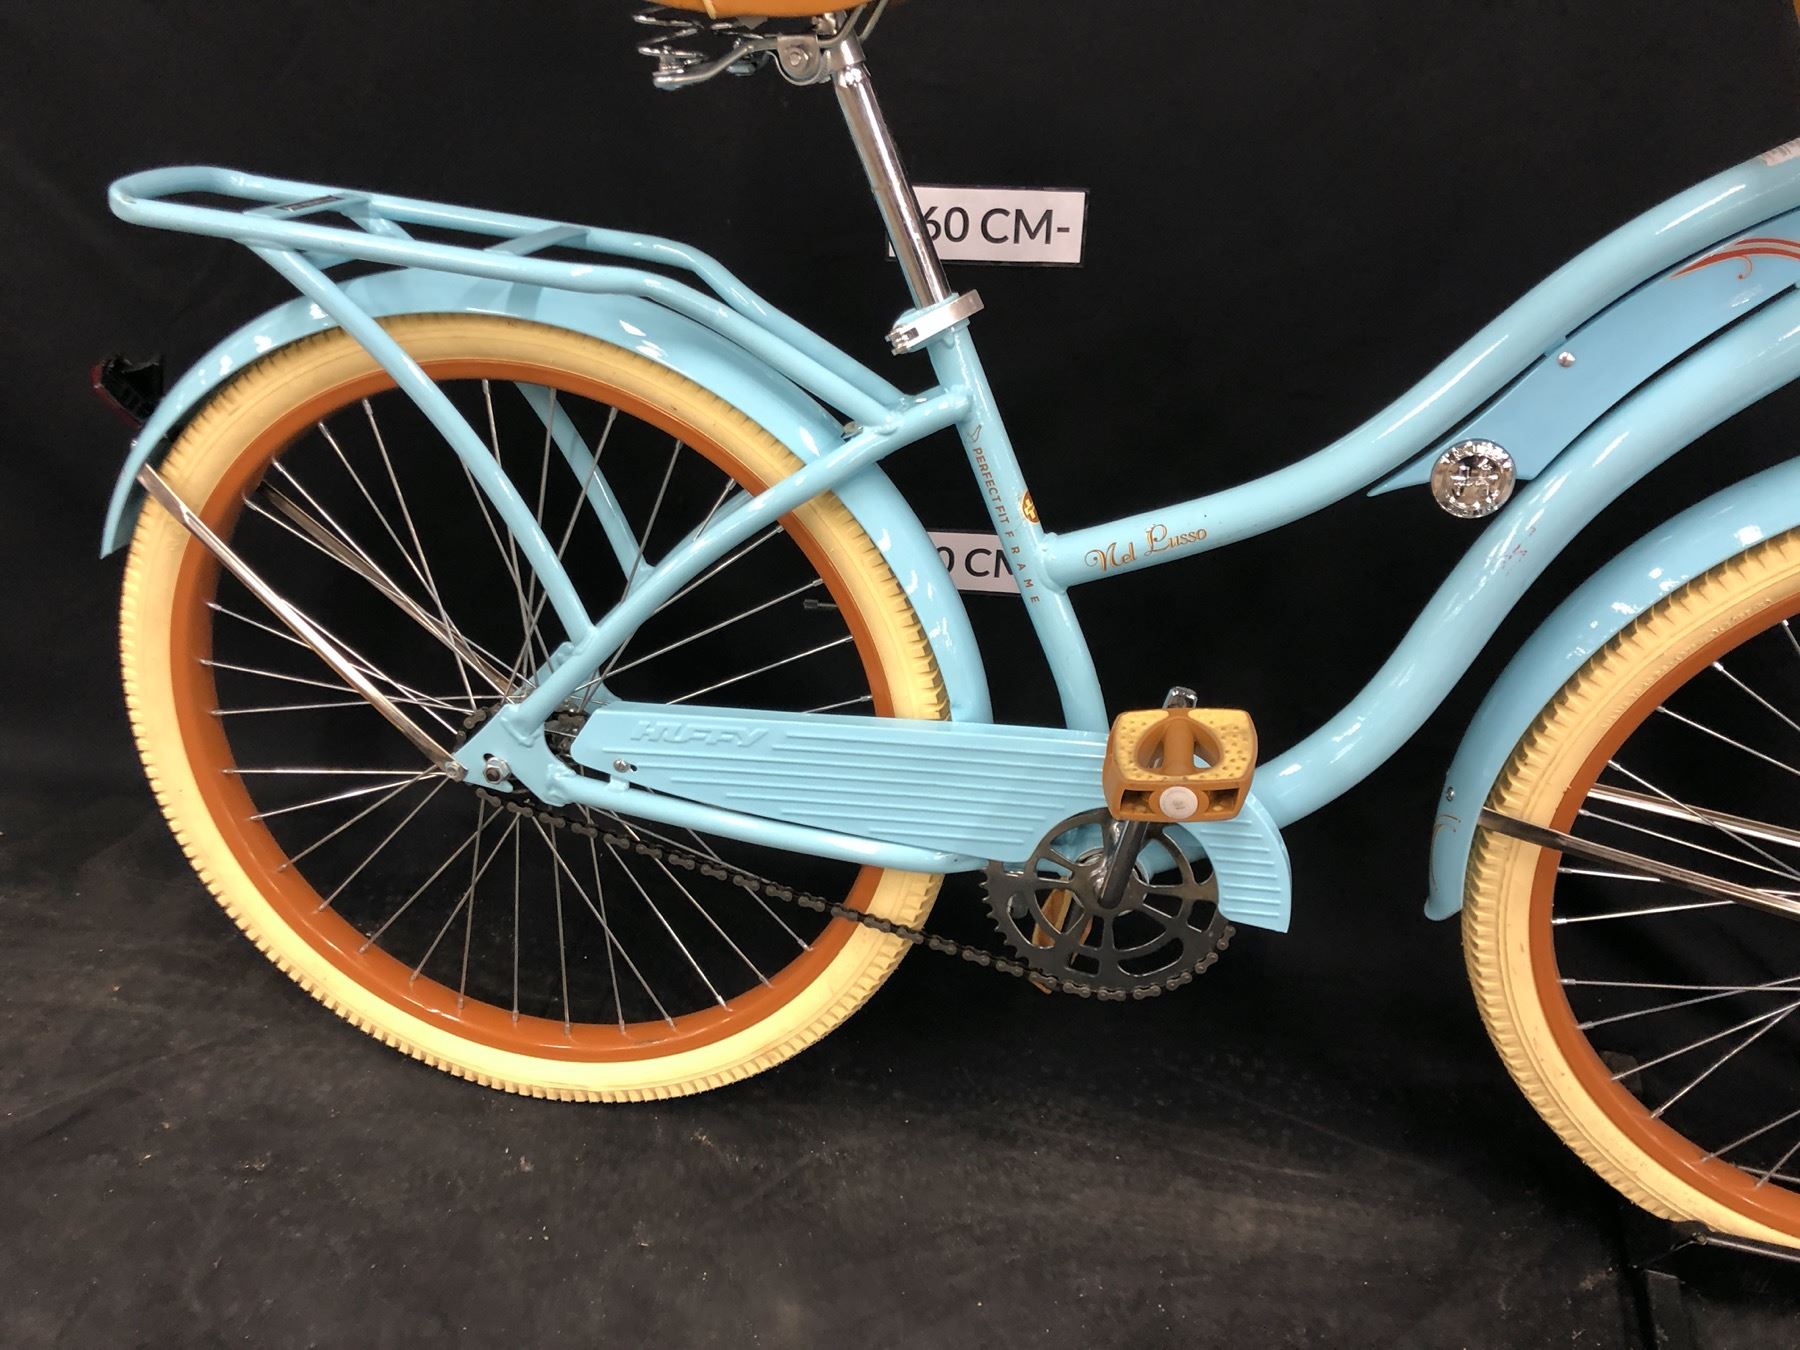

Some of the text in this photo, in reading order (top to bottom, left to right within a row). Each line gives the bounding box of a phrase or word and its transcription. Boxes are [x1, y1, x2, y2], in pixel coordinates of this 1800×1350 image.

[972, 447, 1001, 503] PERFECT
[994, 505, 1010, 524] FIT
[1143, 523, 1208, 556] Lusso
[630, 720, 768, 747] HUFFY
